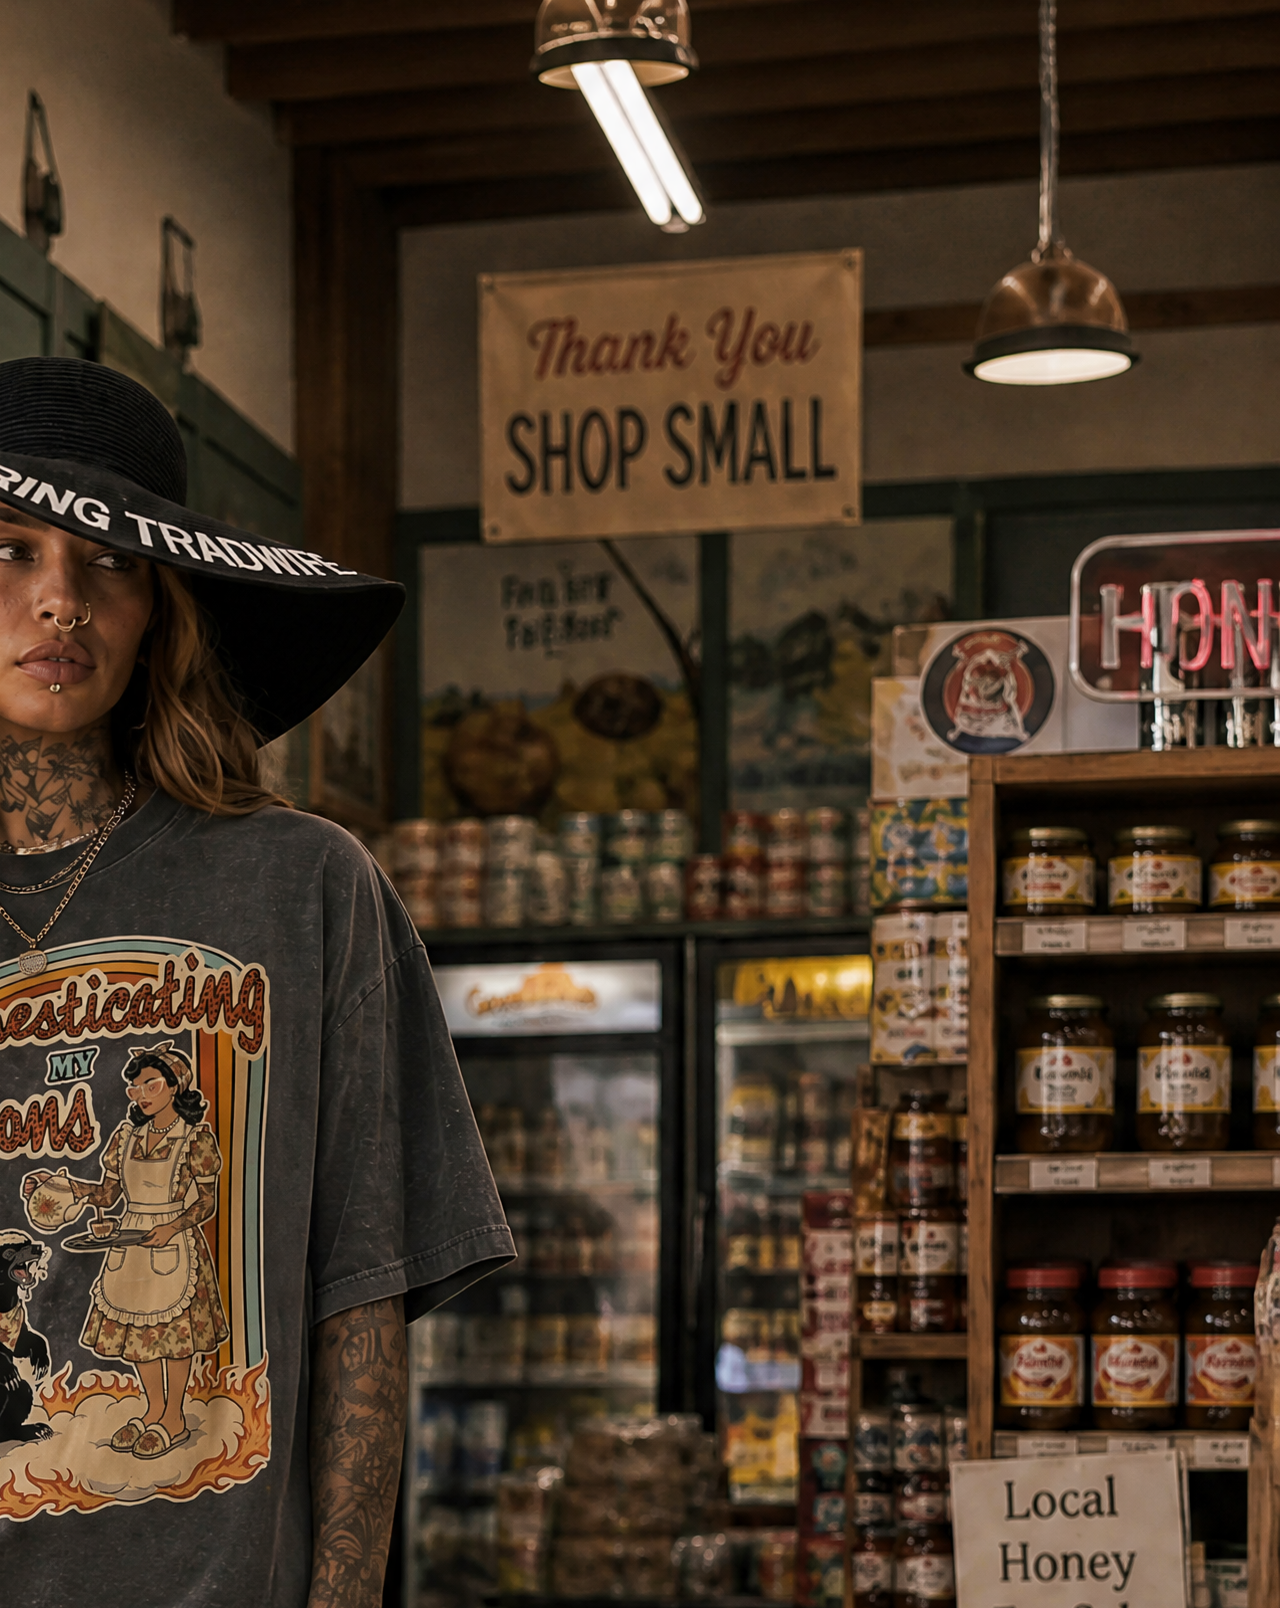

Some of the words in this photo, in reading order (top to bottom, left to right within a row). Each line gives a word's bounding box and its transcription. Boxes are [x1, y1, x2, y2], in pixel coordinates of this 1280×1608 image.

[527, 312, 697, 381] Thank
[706, 307, 819, 390] You
[504, 406, 648, 495] SHOP
[663, 397, 838, 487] SMALL
[1100, 578, 1280, 671] HON
[50, 1049, 96, 1083] MY
[1005, 1476, 1119, 1520] Local
[999, 1542, 1137, 1592] Honey
